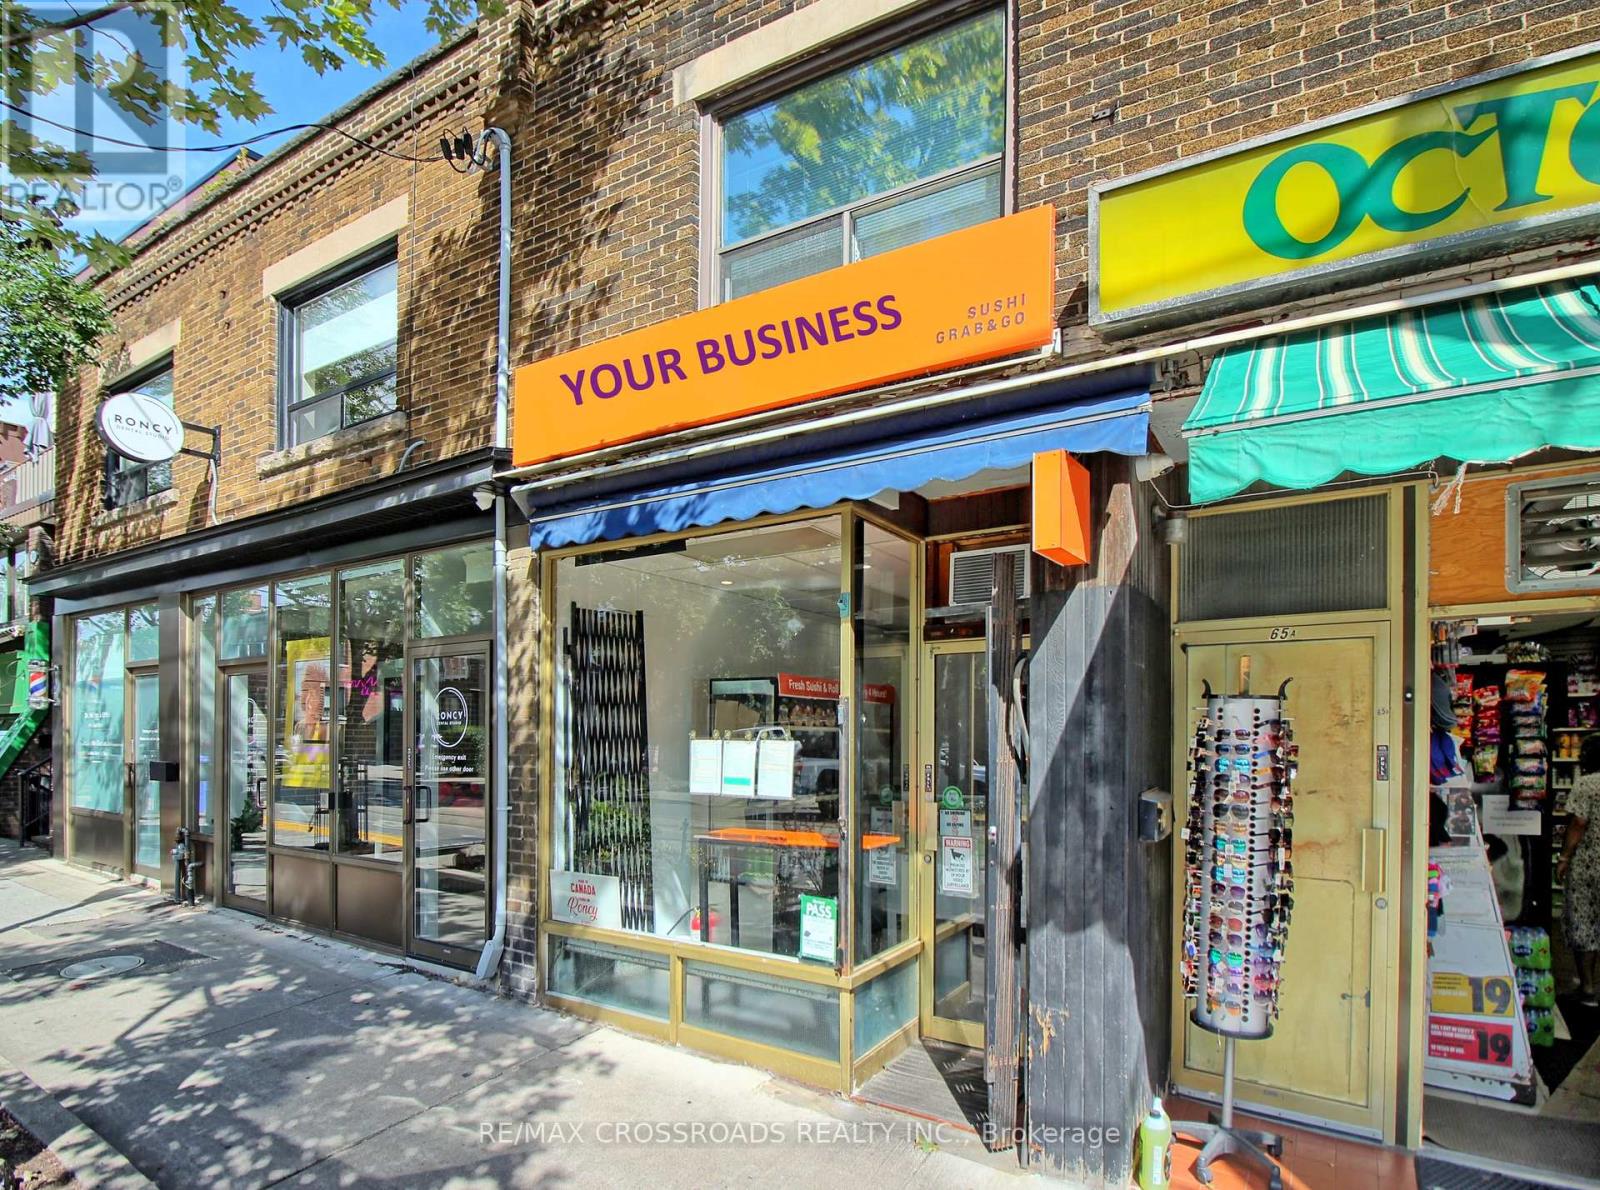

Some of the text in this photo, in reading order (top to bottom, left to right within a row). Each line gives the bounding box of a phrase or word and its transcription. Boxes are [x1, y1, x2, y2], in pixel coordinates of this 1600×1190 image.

[968, 293, 1025, 319] SUSHI
[936, 312, 1025, 344] GRAB&GO
[560, 294, 902, 405] YOUR BUSINESS
[114, 414, 172, 434] RONCY
[788, 679, 805, 690] Fresh
[806, 681, 822, 692] Sushi
[437, 711, 464, 720] ONCY
[945, 839, 971, 848] WARNING
[570, 883, 596, 896] CANADA
[567, 896, 598, 921] Roncy
[806, 901, 832, 918] PASS
[1468, 976, 1511, 1014] 19
[1477, 1029, 1511, 1062] 19
